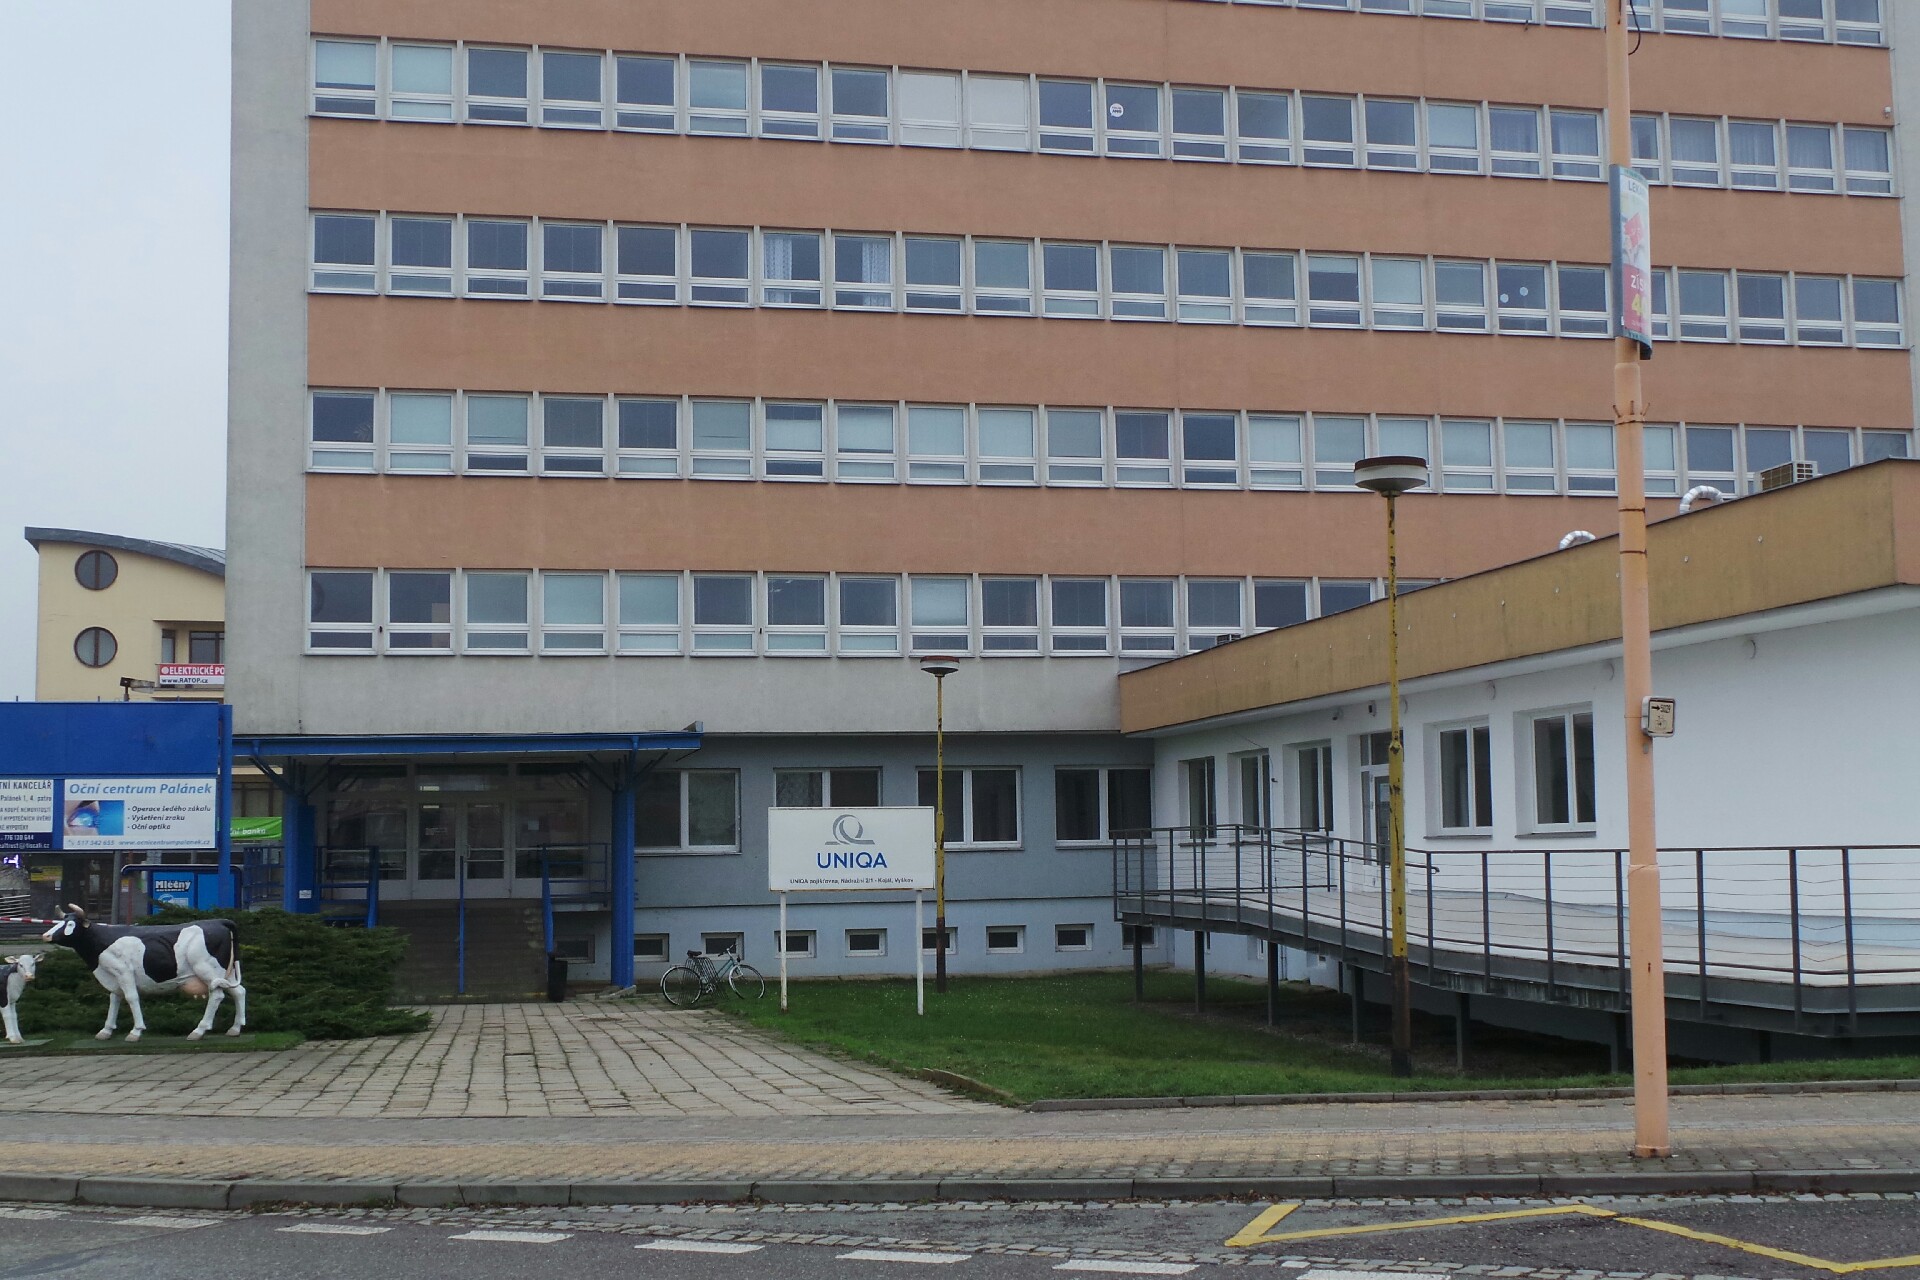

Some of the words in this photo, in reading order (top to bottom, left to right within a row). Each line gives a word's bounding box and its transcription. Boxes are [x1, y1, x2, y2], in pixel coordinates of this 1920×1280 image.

[169, 665, 214, 675] ELEKTRICKÉ
[13, 780, 52, 789] KANCELÁŘ
[69, 783, 101, 794] Oční
[102, 785, 156, 794] centrum
[159, 783, 212, 794] Palánek
[131, 805, 160, 813] Operace
[161, 804, 187, 812] šedého
[148, 823, 171, 831] optika
[817, 852, 887, 868] UNIQA
